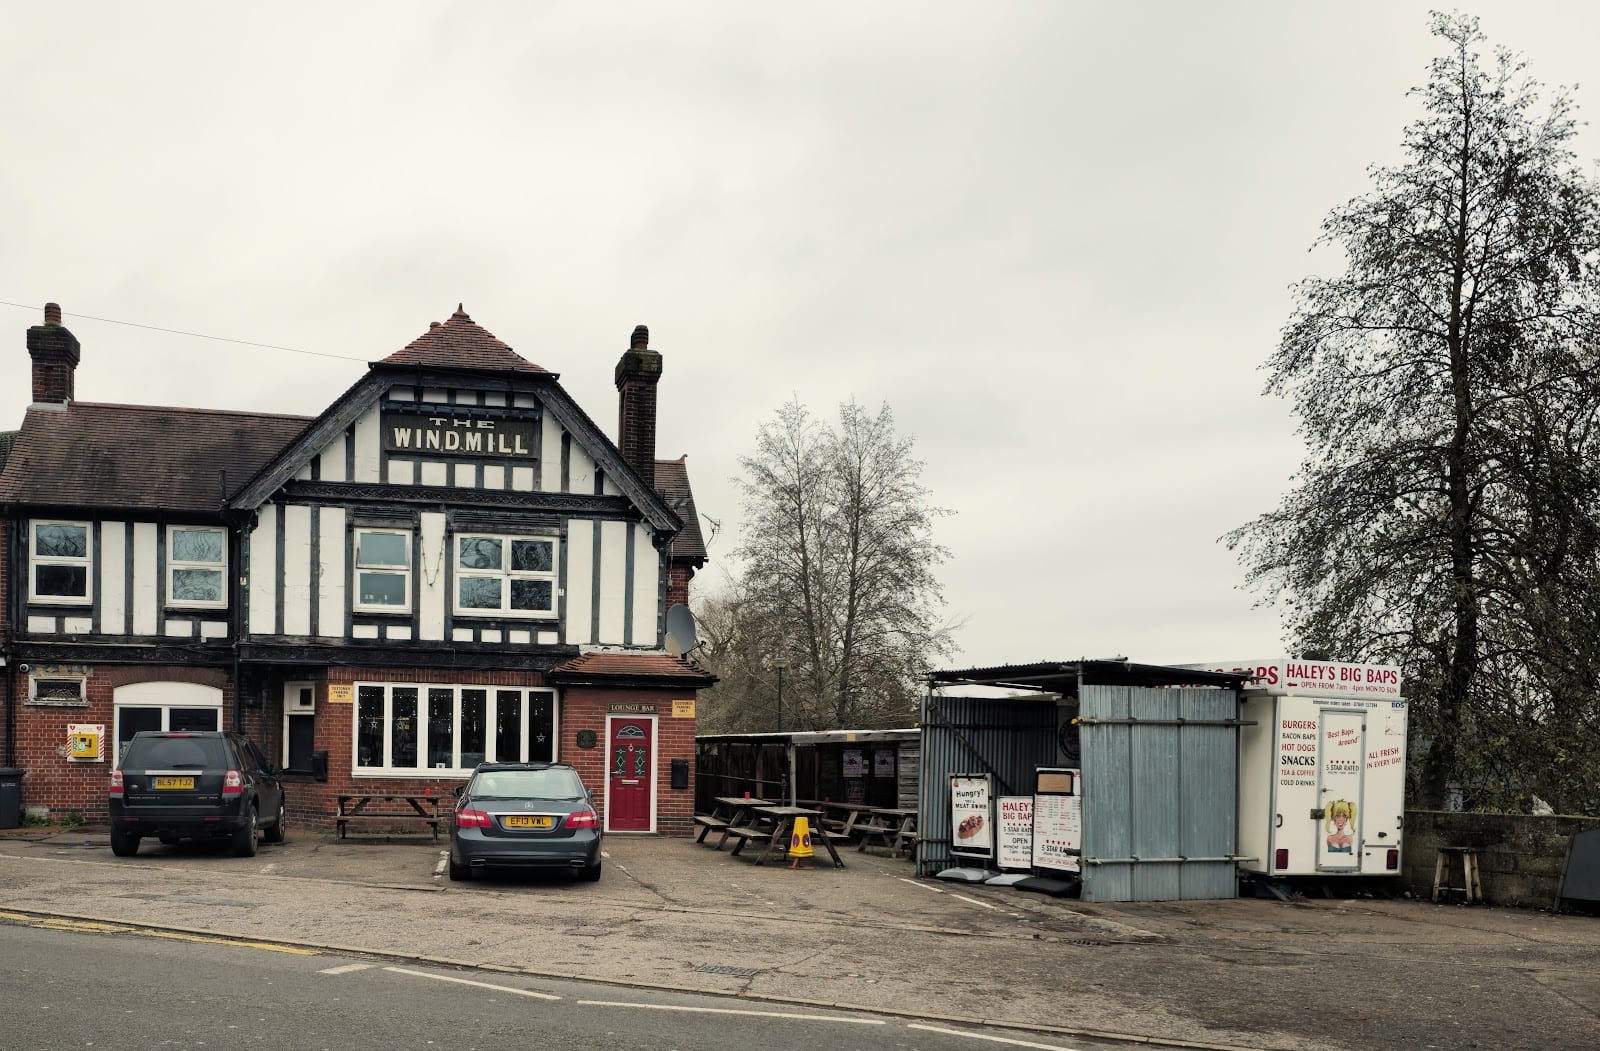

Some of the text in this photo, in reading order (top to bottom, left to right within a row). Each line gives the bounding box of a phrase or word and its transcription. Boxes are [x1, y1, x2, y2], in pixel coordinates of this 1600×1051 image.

[429, 417, 495, 429] THE
[394, 427, 529, 454] WINDMILL
[1286, 664, 1398, 685] HALEY'S BIG BAPS
[1318, 682, 1335, 690] FROM
[1387, 686, 1398, 694] SUN
[611, 704, 639, 712] LOUNGE
[1282, 720, 1317, 730] BURGERS
[1281, 743, 1316, 752] HOT DOGS
[1368, 747, 1399, 760] ALL FRESH
[1281, 755, 1316, 766] SNACKS
[1374, 759, 1390, 768] EVERY
[1391, 757, 1402, 765] DAY
[956, 788, 985, 798] Hungry?
[1002, 812, 1016, 820] BIG
[1046, 845, 1058, 853] STAR
